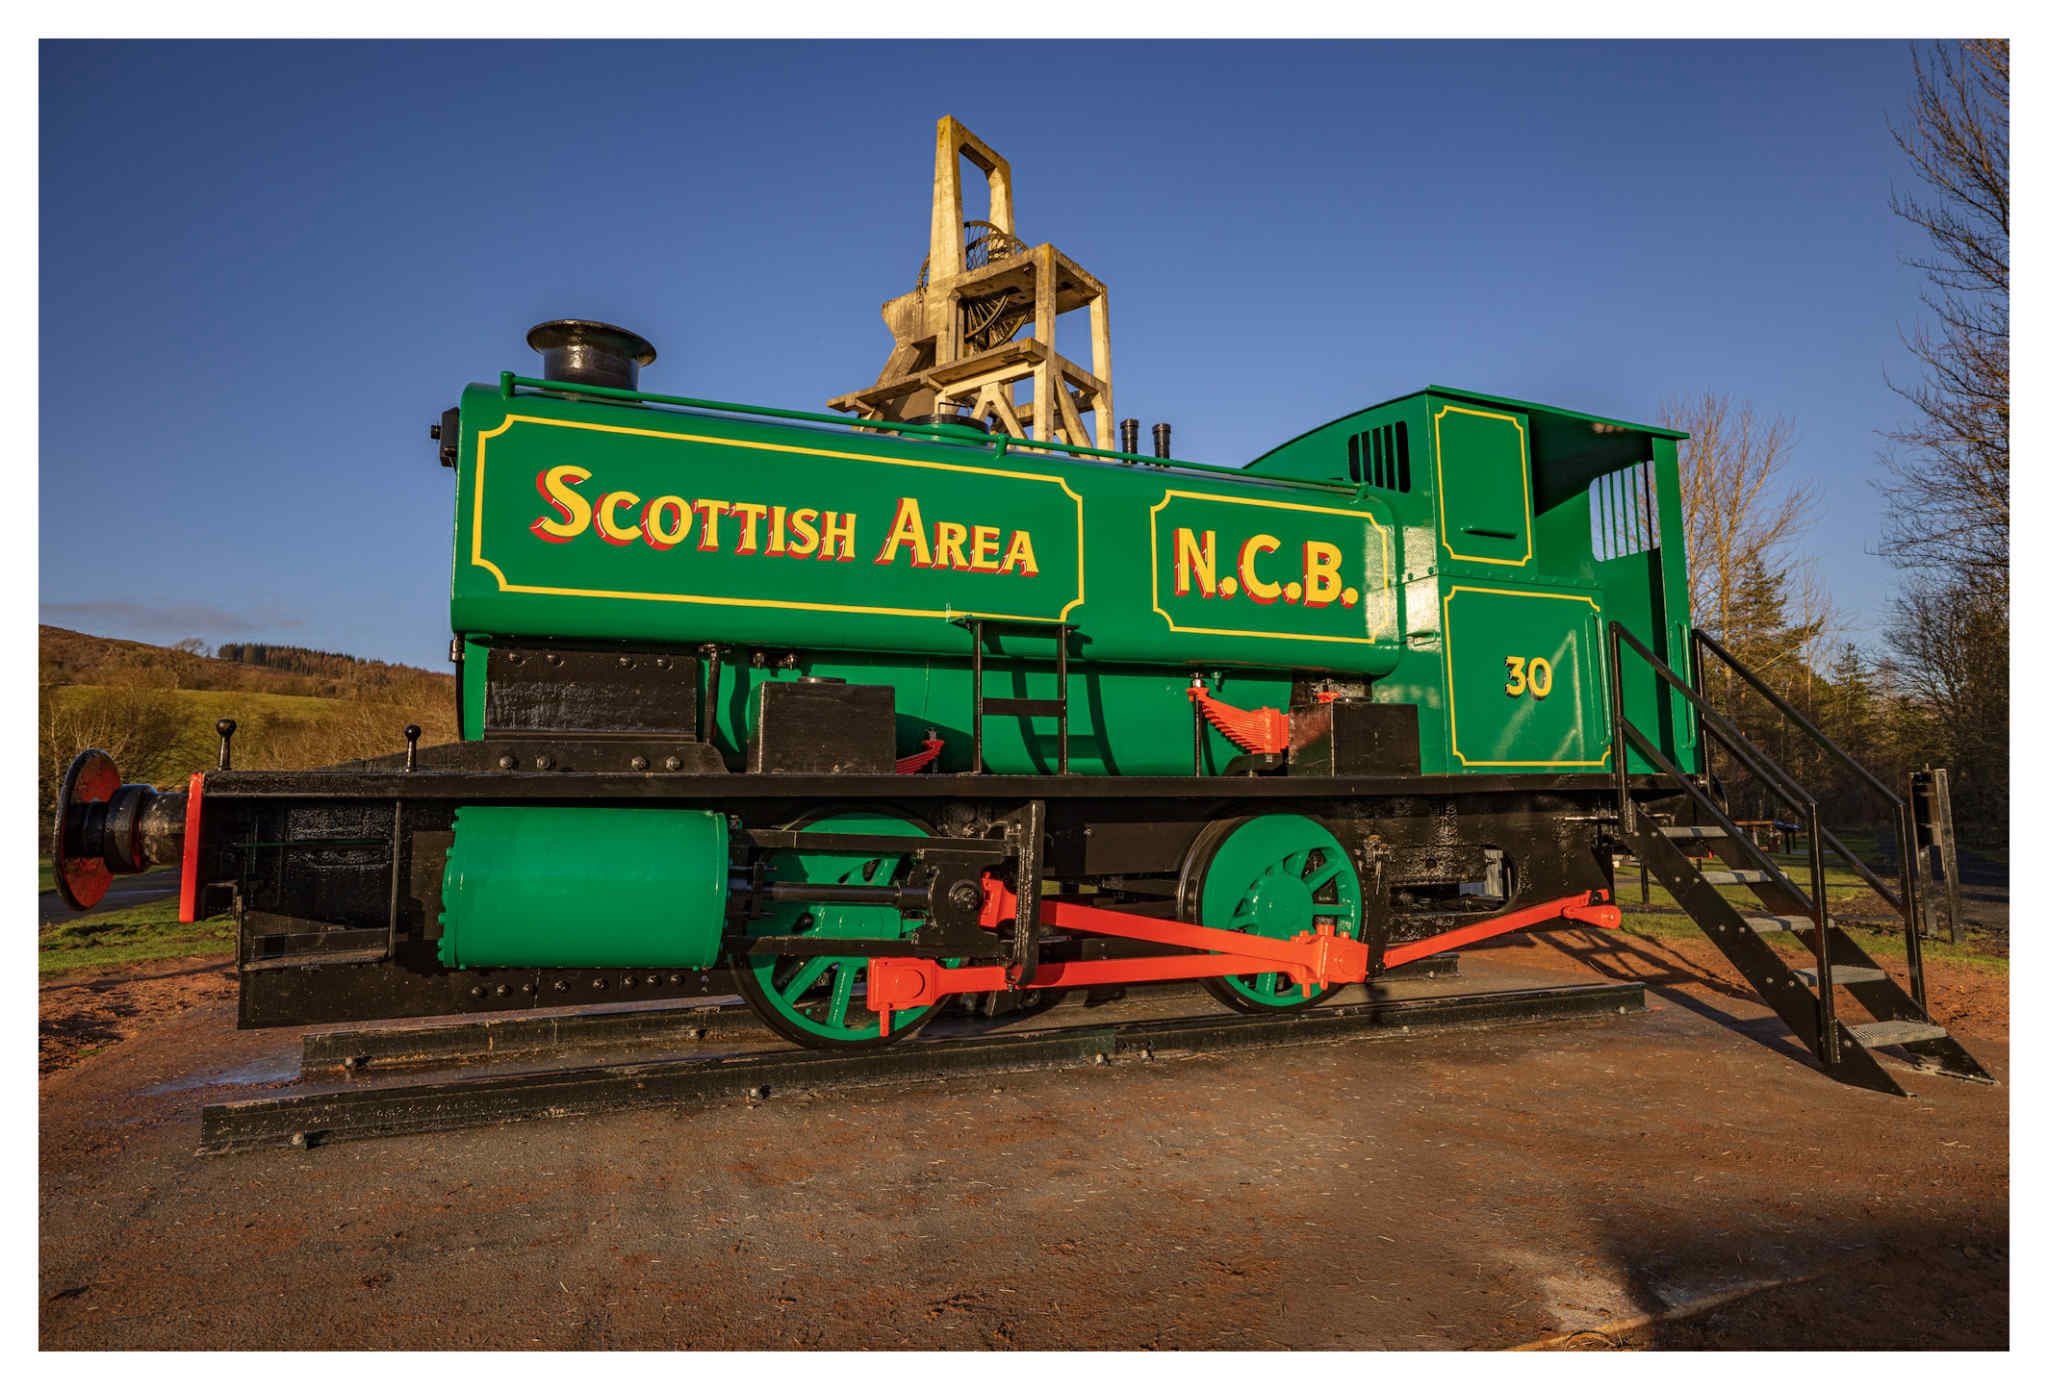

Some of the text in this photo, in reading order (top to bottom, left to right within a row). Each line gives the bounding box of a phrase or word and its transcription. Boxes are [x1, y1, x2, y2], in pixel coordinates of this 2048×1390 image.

[529, 465, 1039, 577] SCOTTISH AREA
[1174, 528, 1359, 608] N.C.B.
[1505, 656, 1553, 699] 30
